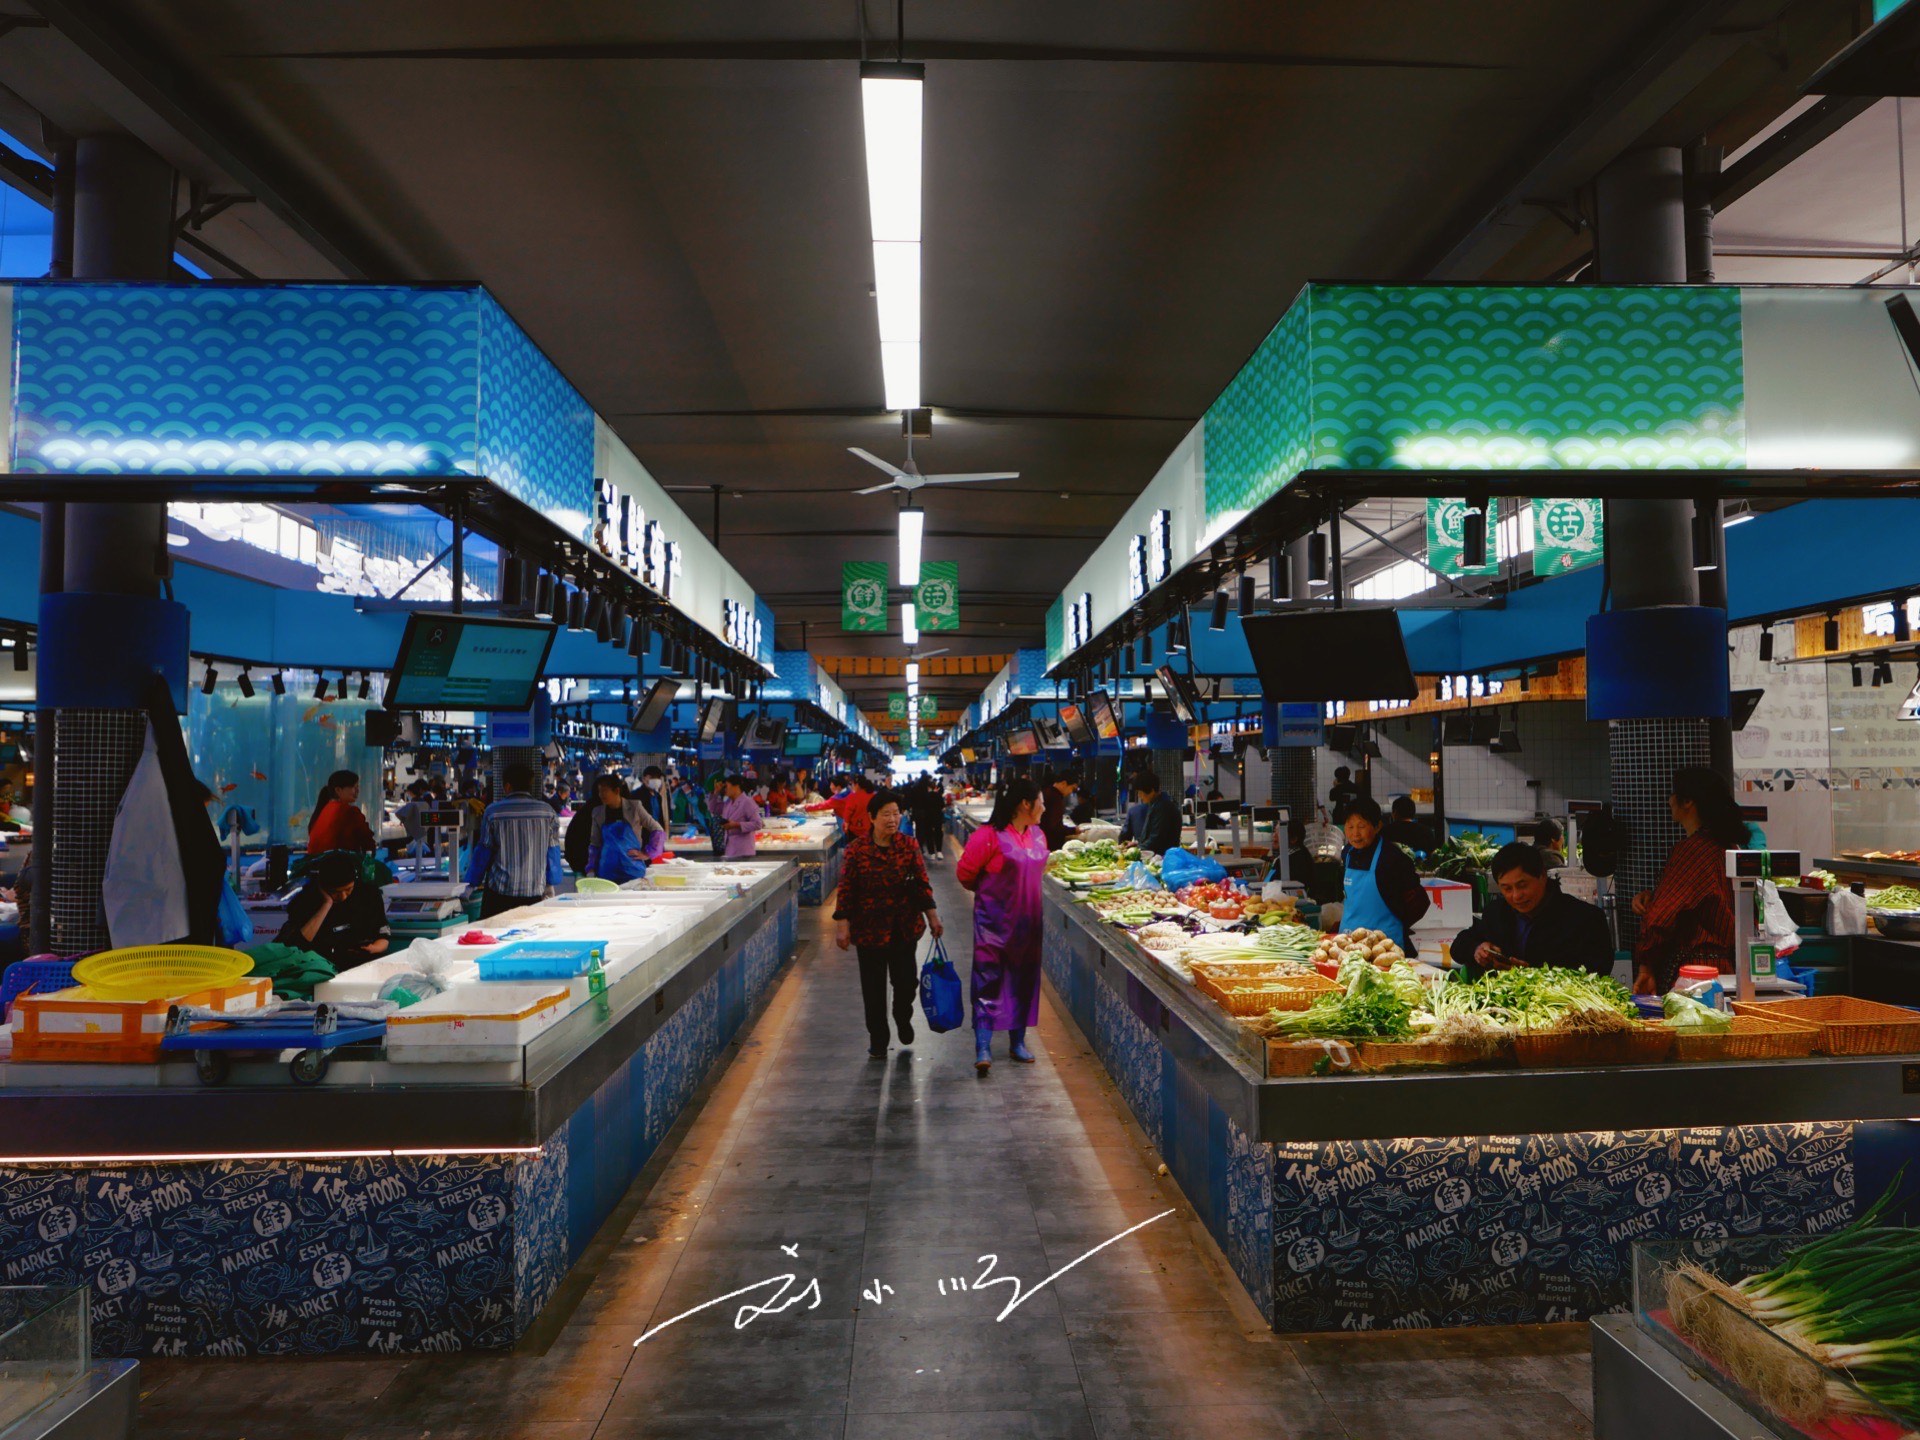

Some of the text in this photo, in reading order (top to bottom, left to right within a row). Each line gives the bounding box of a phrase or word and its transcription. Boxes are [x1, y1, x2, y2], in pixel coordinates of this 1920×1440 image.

[1550, 506, 1580, 539] 活
[925, 586, 944, 606] 活
[1691, 1127, 1722, 1136] Foods
[1489, 1135, 1521, 1145] Foods
[1683, 1136, 1717, 1146] Market
[1286, 1142, 1319, 1150] Foods
[1482, 1145, 1516, 1154] Market
[1278, 1151, 1313, 1160] Market
[1739, 1144, 1777, 1177] FOODS
[305, 1164, 342, 1174] Market
[1539, 1153, 1578, 1186] FOODS
[1806, 1152, 1847, 1178] FRESH
[91, 1169, 127, 1179] Market
[1336, 1158, 1376, 1192] FOODS
[1406, 1167, 1449, 1192] FRESH
[1607, 1161, 1649, 1187] FRESH
[151, 1179, 192, 1213] FOODS
[366, 1174, 407, 1207] FOODS
[438, 1183, 483, 1209] FRESH
[8, 1194, 53, 1220] FRESH
[224, 1189, 268, 1215] FRESH
[1607, 1208, 1661, 1244] MARKET
[1405, 1214, 1460, 1250] MARKET
[436, 1232, 494, 1269] MARKET
[7, 1243, 65, 1280] MARKET
[222, 1238, 279, 1275] MARKET
[1335, 1279, 1368, 1288] Fresh
[1539, 1273, 1571, 1283] Fresh
[1545, 1284, 1577, 1293] Foods
[1342, 1290, 1374, 1299] Foods
[1538, 1293, 1571, 1302] Market
[362, 1296, 396, 1307] Fresh
[1334, 1300, 1368, 1309] Market
[147, 1303, 181, 1313] Fresh
[369, 1307, 402, 1318] Foods
[154, 1314, 187, 1324] Foods
[360, 1317, 397, 1327] Market
[145, 1323, 182, 1333] Market
